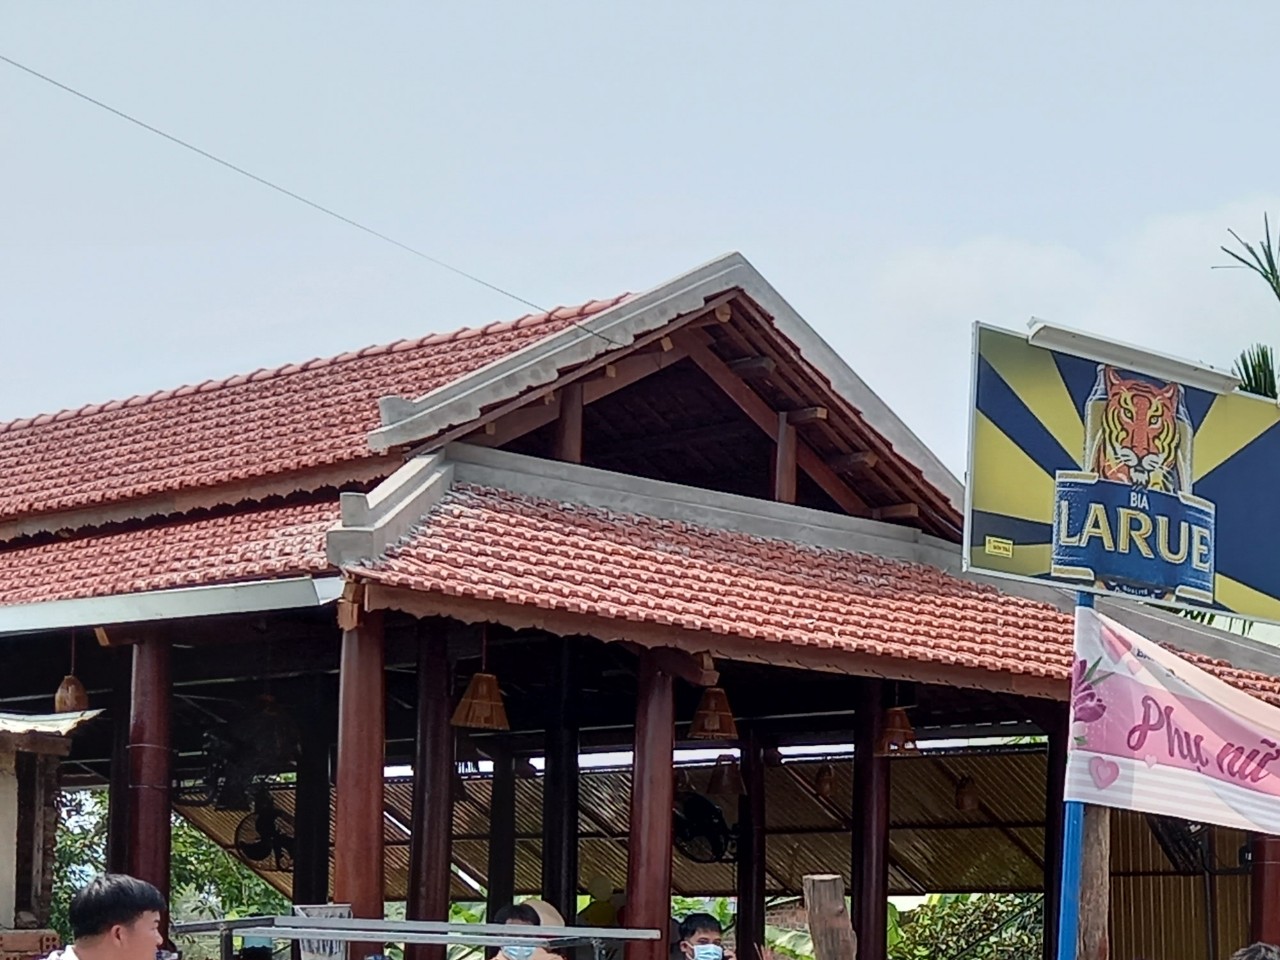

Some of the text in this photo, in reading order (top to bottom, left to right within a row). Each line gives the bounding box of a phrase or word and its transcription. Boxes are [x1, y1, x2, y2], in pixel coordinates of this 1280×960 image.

[1059, 500, 1212, 572] LARUE
[1130, 492, 1149, 510] BIA
[1127, 695, 1209, 773] Phụ
[1216, 740, 1280, 785] nữ
